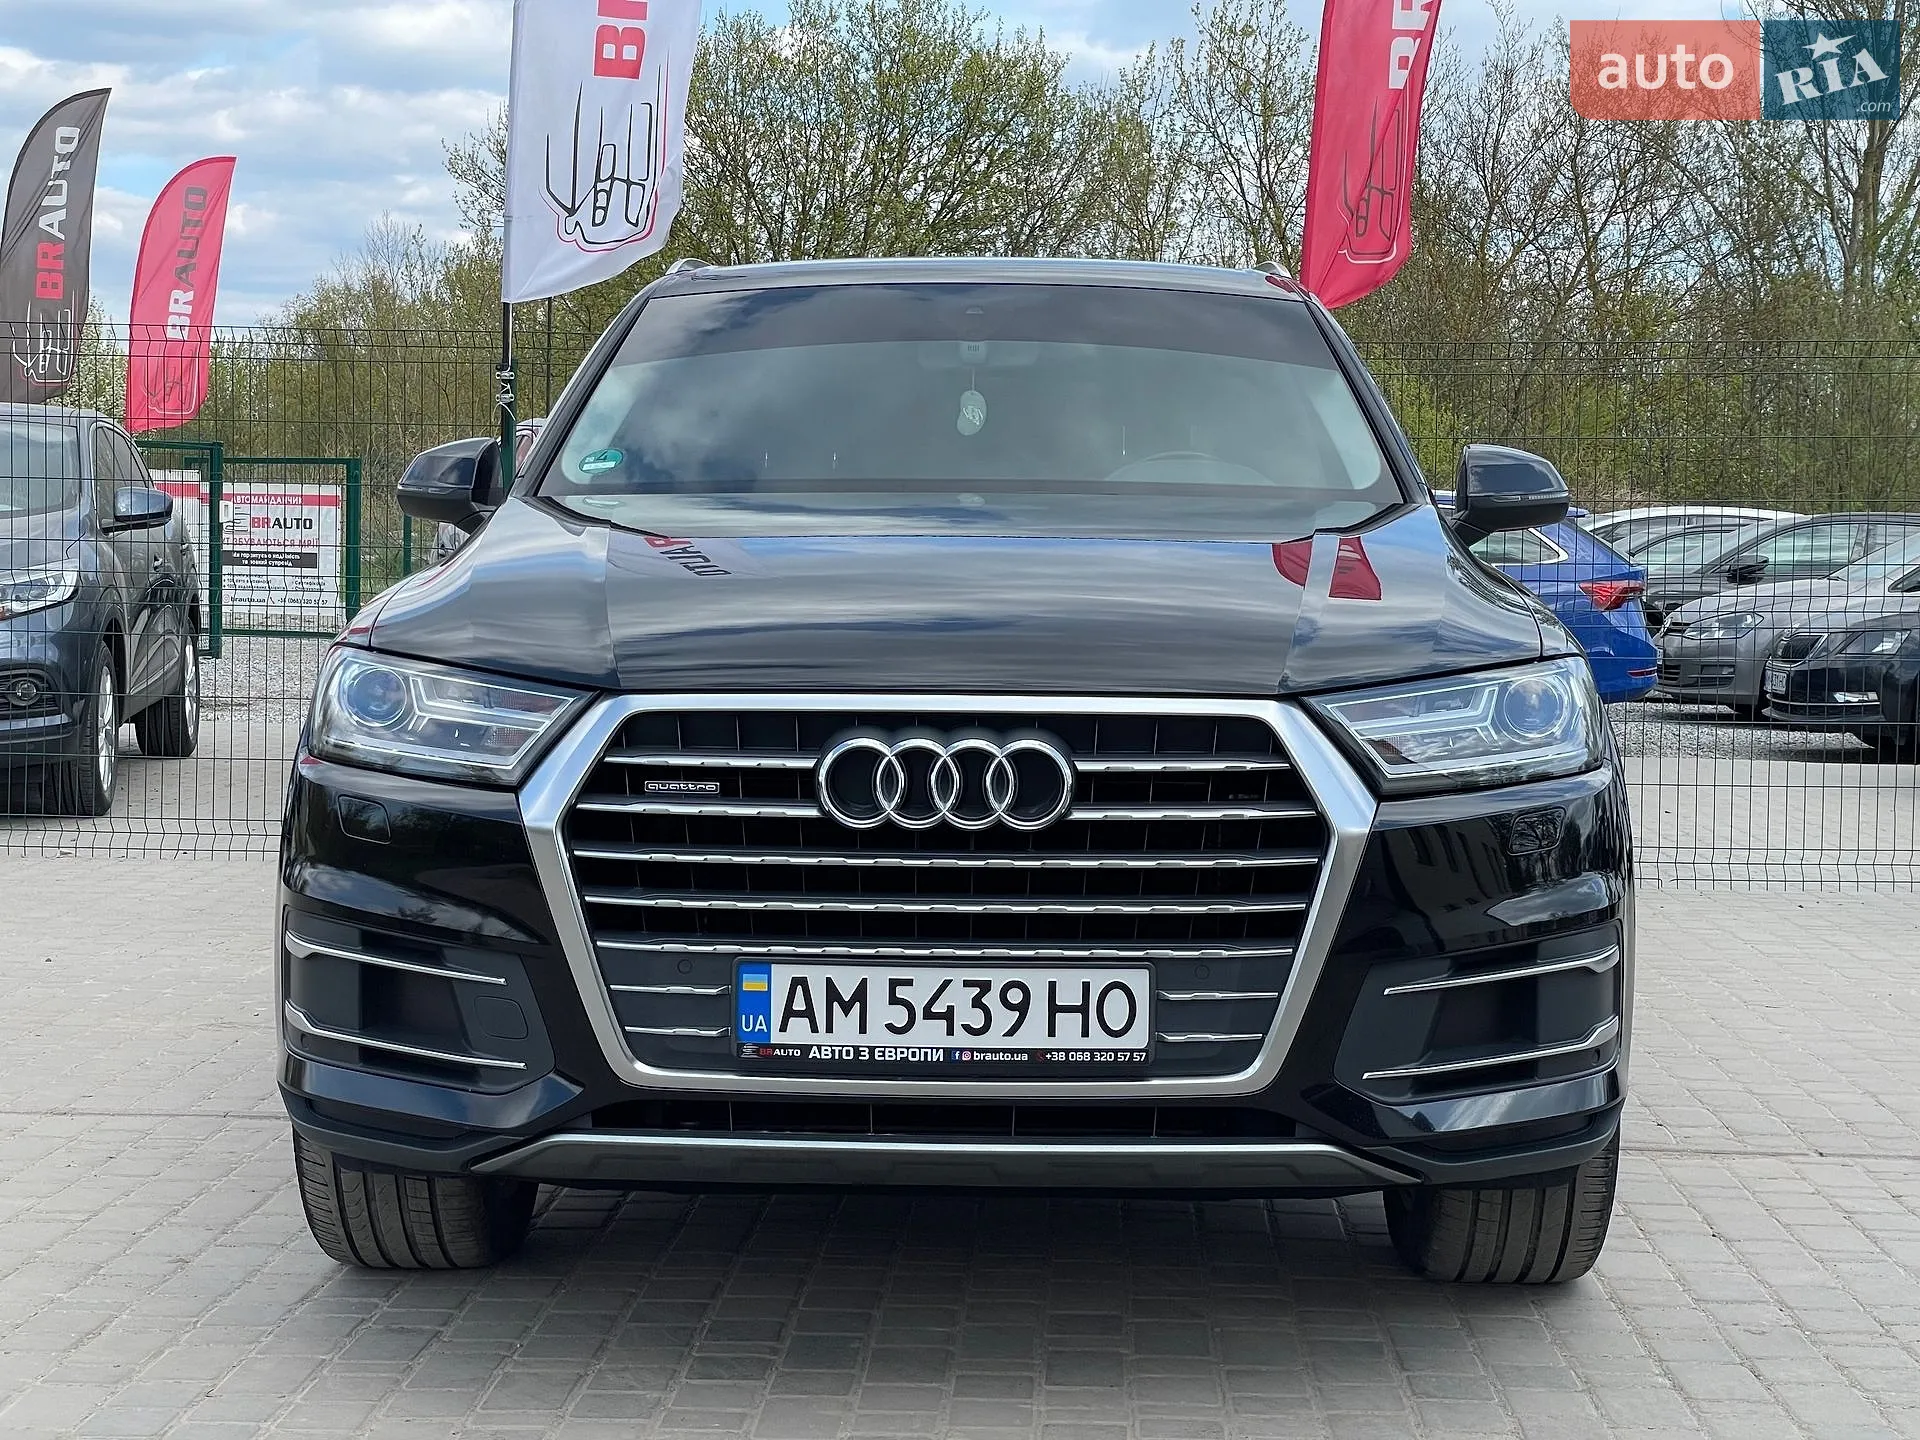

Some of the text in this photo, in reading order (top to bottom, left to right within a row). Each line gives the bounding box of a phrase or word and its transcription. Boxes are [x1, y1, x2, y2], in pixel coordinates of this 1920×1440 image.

[36, 126, 81, 300] BRAUTO
[167, 186, 209, 341] BRAUTO
[251, 516, 313, 530] BRAUTO
[779, 976, 1137, 1038] AM 5439 HO
[741, 1015, 768, 1033] UA
[759, 1048, 801, 1057] BRAUTO
[809, 1046, 854, 1060] АВТО
[874, 1048, 944, 1062] ЄВРОПИ
[973, 1051, 1029, 1061] brauto.ua
[1045, 1051, 1147, 1062] +38 068 320 57 57
